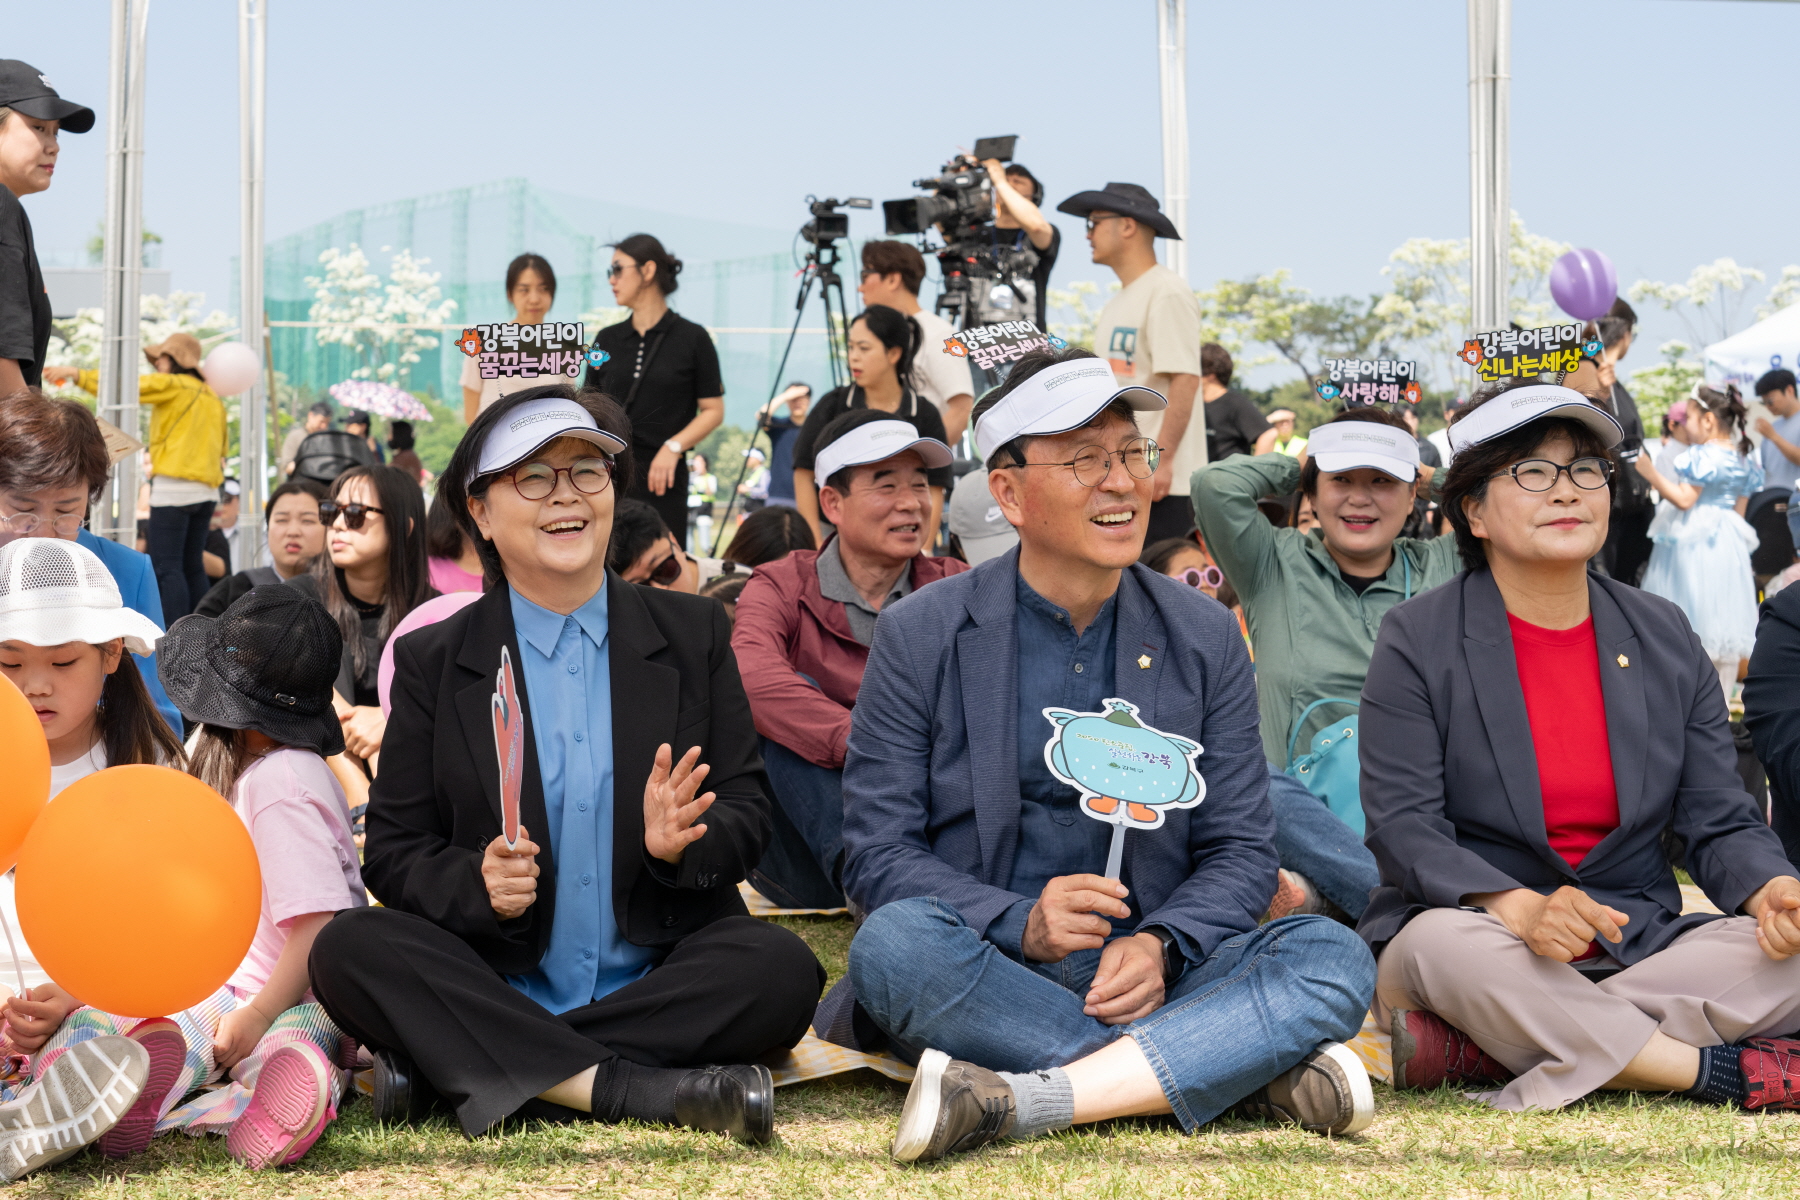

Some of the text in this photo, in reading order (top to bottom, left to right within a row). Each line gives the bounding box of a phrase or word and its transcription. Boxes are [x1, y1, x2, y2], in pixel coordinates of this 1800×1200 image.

[477, 322, 583, 352] 강북어린이
[953, 320, 1041, 350] 강북어린이
[1477, 323, 1581, 358] 강북어린이
[479, 350, 584, 379] 꿈꾸는세상
[1325, 359, 1415, 382] 강북어린이
[1477, 347, 1582, 381] 신나는세상
[1339, 382, 1399, 405] 사랑해
[1108, 748, 1173, 770] 실천하는 강북
